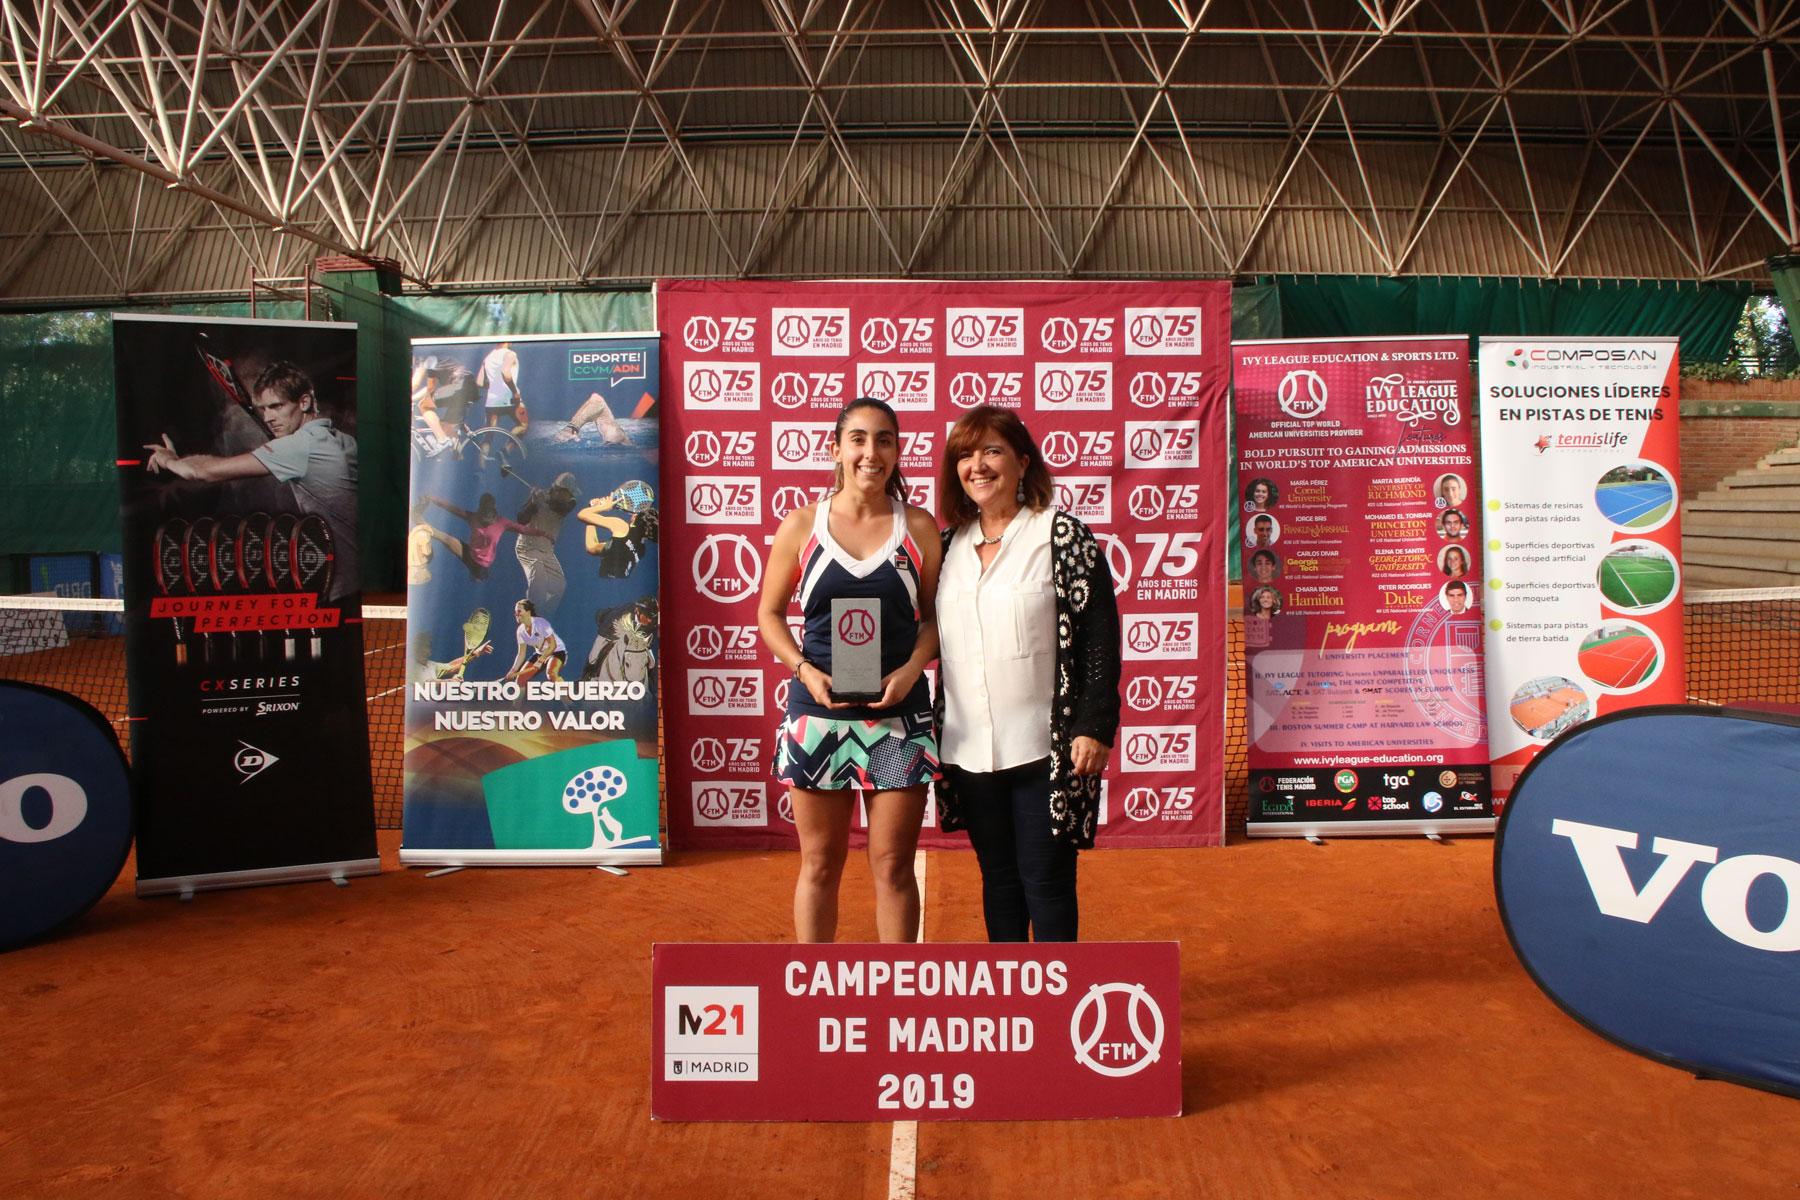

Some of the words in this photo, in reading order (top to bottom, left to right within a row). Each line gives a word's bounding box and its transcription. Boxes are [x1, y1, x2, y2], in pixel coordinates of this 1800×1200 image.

[721, 317, 756, 341] 75
[812, 316, 844, 337] 75
[899, 318, 935, 341] 75
[986, 316, 1018, 337] 75
[1079, 318, 1115, 341] 75
[1164, 315, 1196, 336] 75
[695, 339, 709, 347] FTM
[786, 336, 800, 344] FTM
[871, 340, 887, 348] FTM
[961, 335, 975, 343] FTM
[1052, 339, 1067, 348] FTM
[1140, 335, 1153, 343] FTM
[573, 353, 640, 364] DEPORTE!
[1242, 357, 1261, 365] IVY
[1265, 355, 1310, 365] LEAGUE
[1312, 353, 1378, 364] EDUCATION
[1380, 353, 1389, 361] &
[1392, 352, 1432, 361] SPORTS
[1434, 351, 1459, 360] LTD.
[1530, 350, 1657, 361] COMPOSAN
[574, 364, 640, 375] CCVM/ADN
[723, 370, 755, 392] 75
[809, 373, 845, 396] 75
[897, 371, 929, 392] 75
[987, 373, 1024, 396] 75
[1075, 370, 1107, 392] 75
[1166, 372, 1202, 395] 75
[1400, 384, 1458, 398] LEAGUE
[1490, 386, 1600, 398] SOLUCIONES
[1604, 383, 1671, 398] LÍDERES
[1140, 394, 1155, 402] FTM
[1293, 401, 1314, 410] FTM
[1366, 399, 1460, 420] EDUCATION
[1500, 409, 1521, 421] EN
[1526, 409, 1585, 421] PISTAS
[1589, 409, 1611, 421] DE
[1615, 409, 1664, 421] TENIS
[1164, 428, 1195, 450] 75
[1249, 431, 1284, 439] AMERICAN
[1285, 430, 1329, 438] UNIVERSITIES
[1330, 429, 1364, 437] PROVIDER
[1558, 432, 1628, 448] tennislife
[721, 432, 756, 455] 75
[1244, 449, 1275, 458] BOLD
[1278, 447, 1325, 457] PURSUIT
[1327, 447, 1342, 456] TO
[1345, 446, 1395, 456] GAINING
[1398, 444, 1466, 454] ADMISSIONS
[1240, 461, 1252, 470] IN
[1255, 460, 1307, 470] WORLD'S
[1309, 459, 1330, 468] TOP
[1333, 457, 1396, 468] AMERICAN
[1397, 456, 1472, 465] UNIVERSITIES
[1368, 491, 1427, 499] RICHMOND
[1371, 520, 1427, 529] PRINCETON
[1505, 516, 1523, 524] para
[1525, 515, 1548, 524] pistas
[1550, 515, 1581, 524] rápidas
[1371, 529, 1427, 537] UNIVERSITY
[1505, 542, 1549, 551] Superficies
[1551, 542, 1595, 551] deportivas
[1135, 532, 1203, 578] 75
[1522, 555, 1550, 563] césped
[713, 578, 741, 591] FTM
[1137, 579, 1160, 588] AÑOS
[1161, 580, 1172, 588] DE
[1173, 579, 1198, 588] TENIS
[1506, 582, 1549, 591] Superficies
[1552, 582, 1595, 591] deportivas
[1137, 590, 1152, 600] EN
[1154, 589, 1198, 600] MADRID
[1289, 593, 1344, 606] Hamilton
[1385, 591, 1424, 605] Duke
[158, 599, 258, 613] JOURNEY
[271, 598, 309, 609] FOR
[201, 613, 333, 628] PERFECTION
[1564, 622, 1588, 630] pistas
[724, 626, 759, 648] 75
[850, 632, 865, 640] FTM
[1162, 621, 1193, 642] 75
[697, 647, 712, 655] FTM
[414, 681, 521, 701] NUESTRO
[527, 680, 645, 700] ESFUERZO
[726, 677, 758, 698] 75
[1164, 676, 1198, 699] 75
[256, 701, 300, 715] SRIXON
[1136, 698, 1151, 706] FTM
[434, 711, 542, 731] NUESTRO
[547, 710, 625, 730] VALOR
[727, 739, 761, 761] 75
[1160, 733, 1192, 754] 75
[702, 759, 716, 767] FTM
[1294, 754, 1444, 766] www.ivyleague-education.org
[1277, 776, 1314, 784] FEDERACIÓN
[1337, 776, 1354, 784] PGA
[1383, 773, 1409, 789] tga
[730, 789, 762, 808] 75
[1162, 787, 1196, 809] 75
[1382, 796, 1396, 804] top
[1382, 802, 1409, 810] school
[784, 960, 1068, 997] CAMPEONATOS
[679, 1004, 745, 1035] M21
[819, 1017, 867, 1053] DE
[889, 1016, 1034, 1053] MADRID
[1099, 1043, 1137, 1061] FTM
[691, 1061, 749, 1074] MADRID
[878, 1073, 975, 1110] 2019
